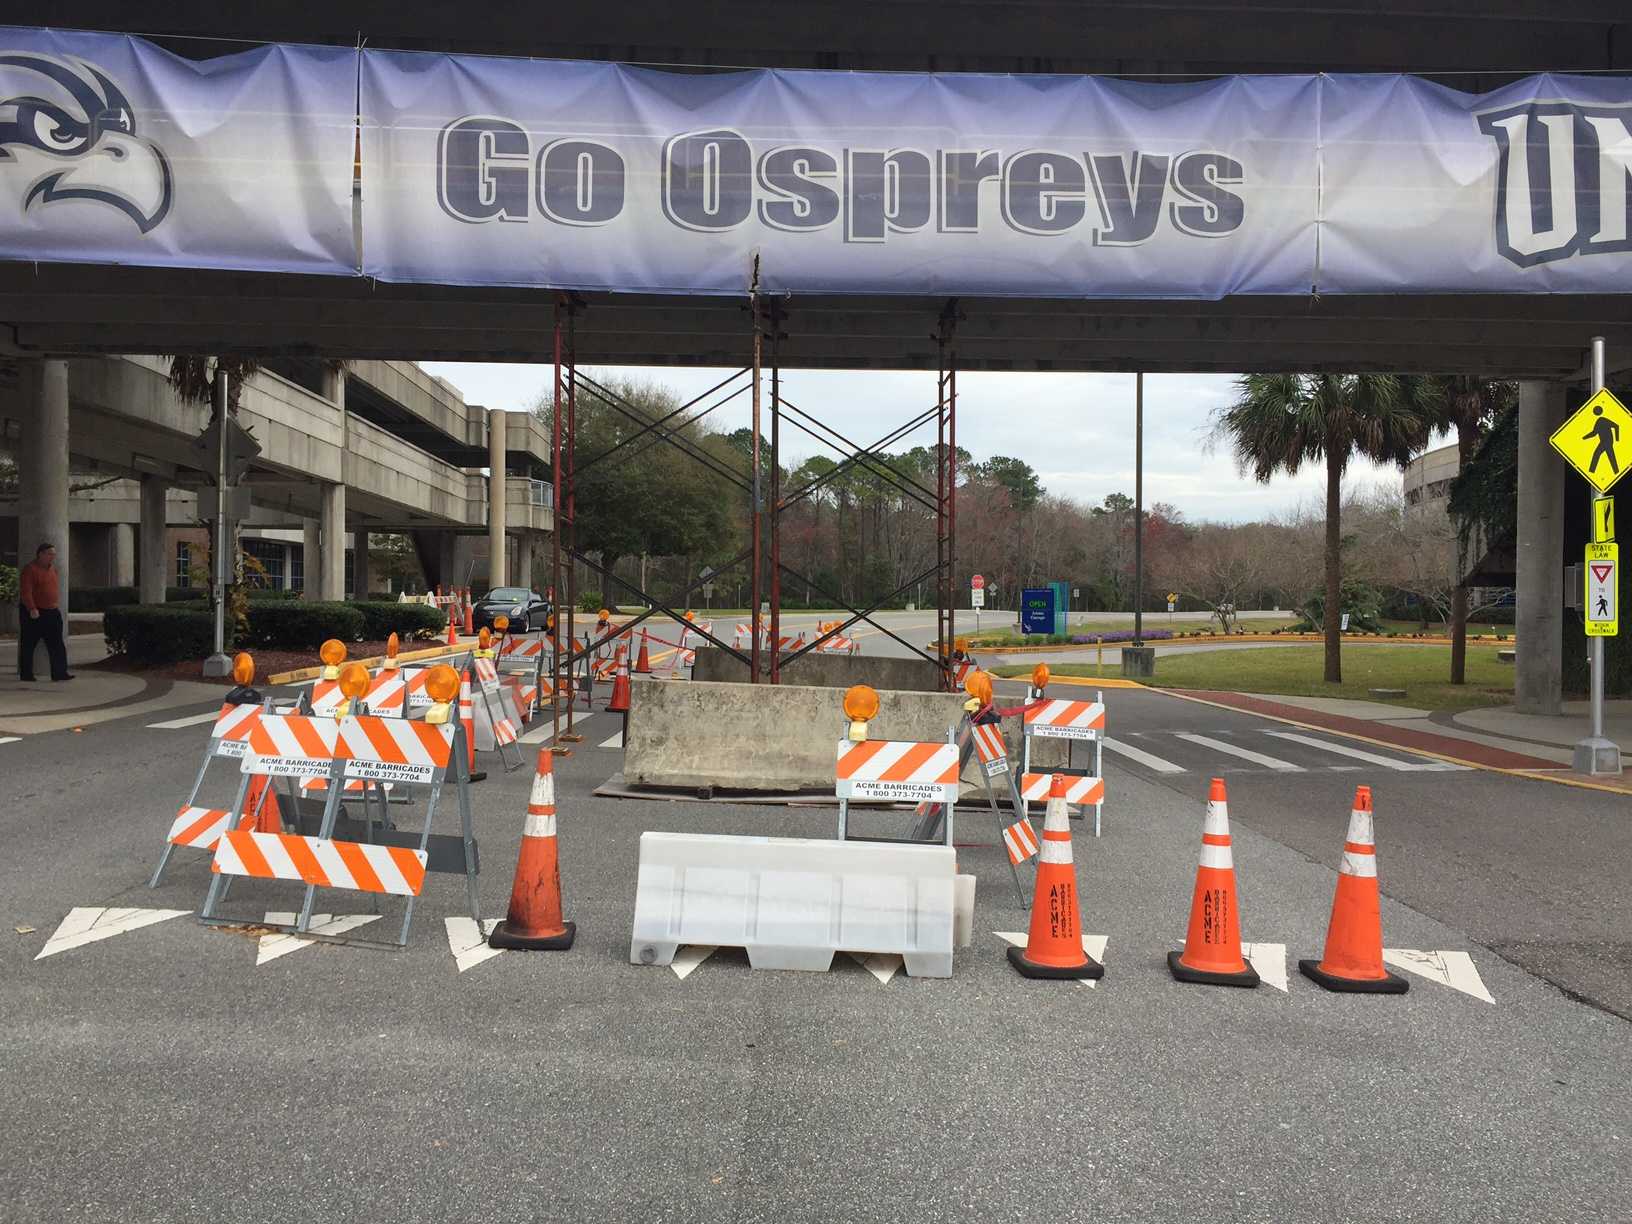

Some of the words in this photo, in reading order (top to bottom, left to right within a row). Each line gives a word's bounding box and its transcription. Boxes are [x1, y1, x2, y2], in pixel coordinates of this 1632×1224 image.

[437, 114, 625, 228] Go
[661, 128, 1245, 248] Ospreys
[349, 760, 374, 769] ACME
[375, 762, 431, 774] BARRICADES
[364, 769, 380, 777] 800
[381, 770, 420, 781] 373-7704
[883, 783, 943, 792] BARRICADES
[892, 790, 932, 799] 373-7704
[1050, 884, 1059, 938] ACME
[1204, 889, 1212, 945] ACME
